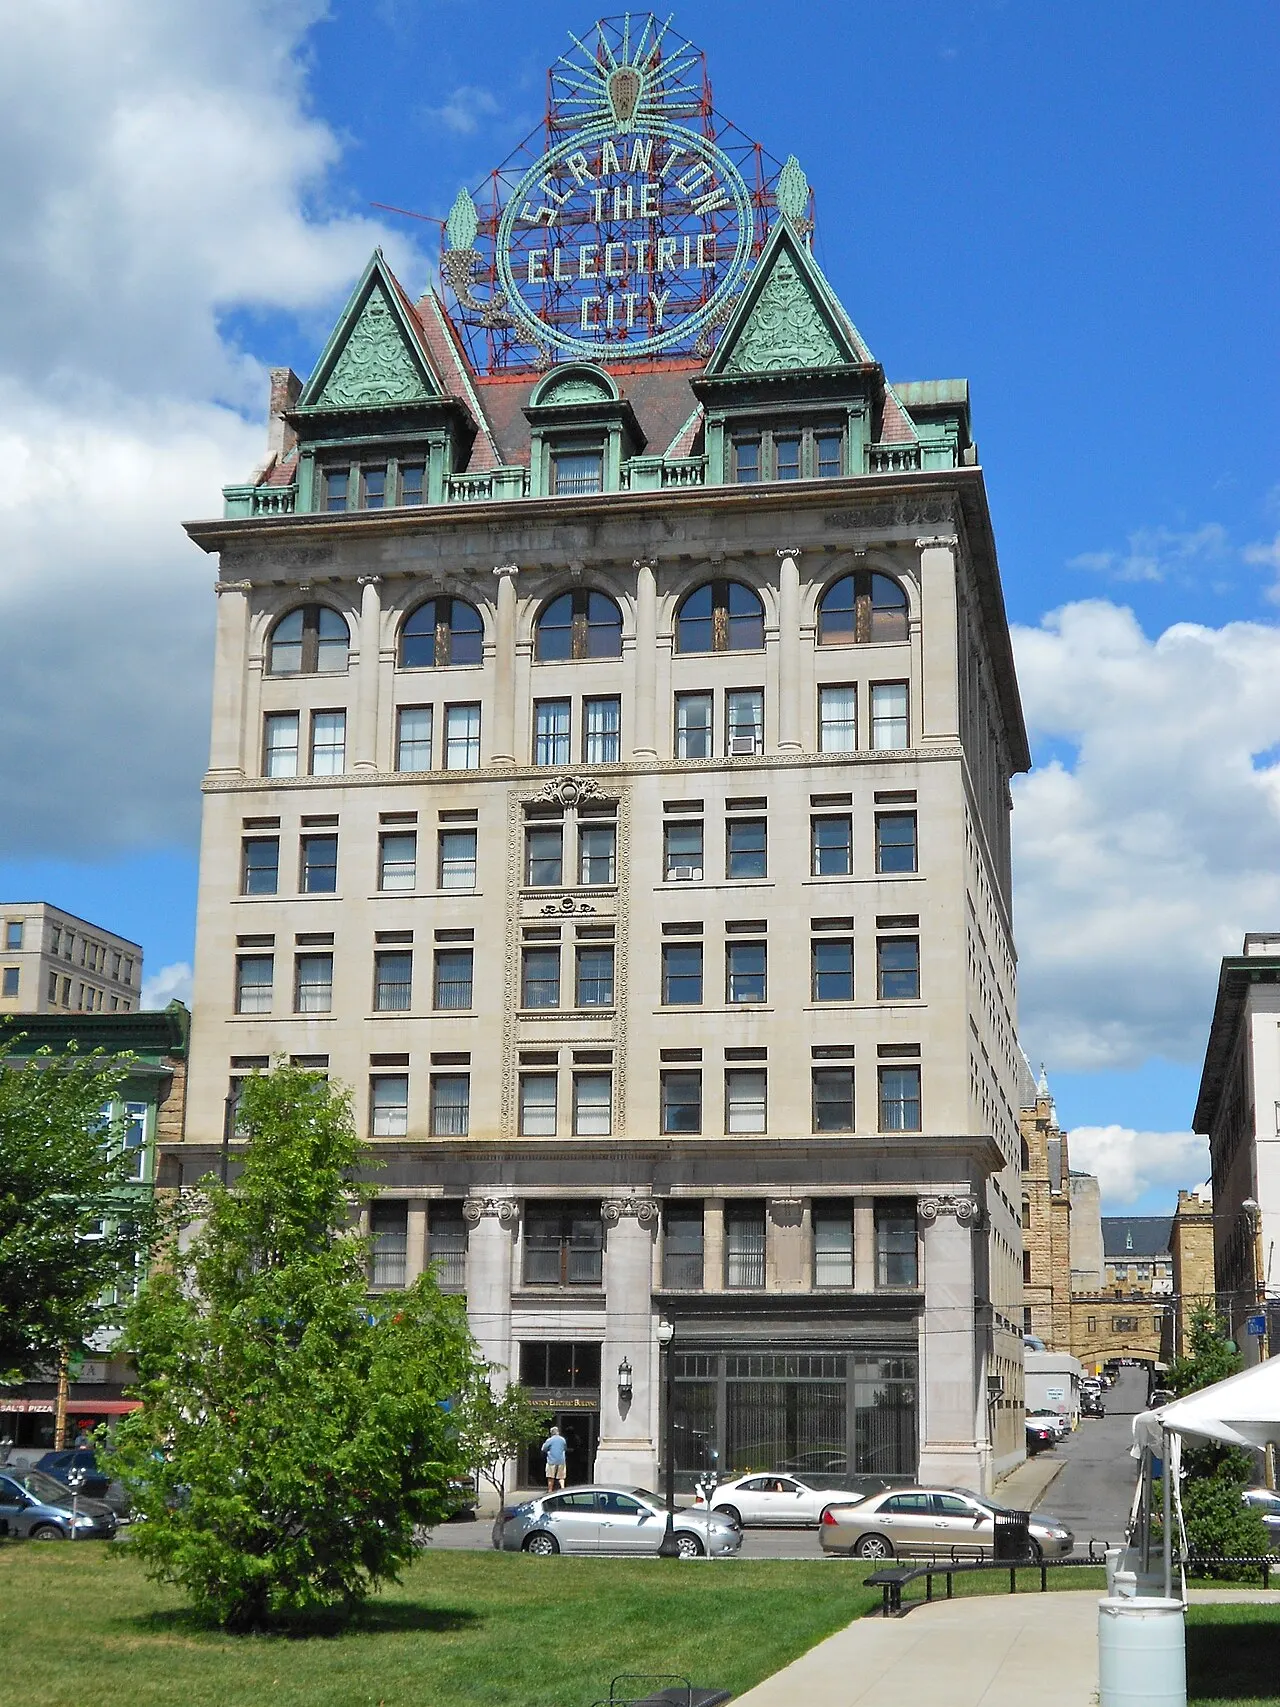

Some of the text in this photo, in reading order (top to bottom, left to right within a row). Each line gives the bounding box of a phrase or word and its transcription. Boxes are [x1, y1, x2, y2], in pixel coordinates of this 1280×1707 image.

[520, 138, 730, 228] SCRANTON
[590, 183, 661, 223] THE
[527, 233, 717, 284] ELECTRIC
[580, 289, 671, 331] CITY
[0, 1404, 54, 1413] SAL'S PIZZA
